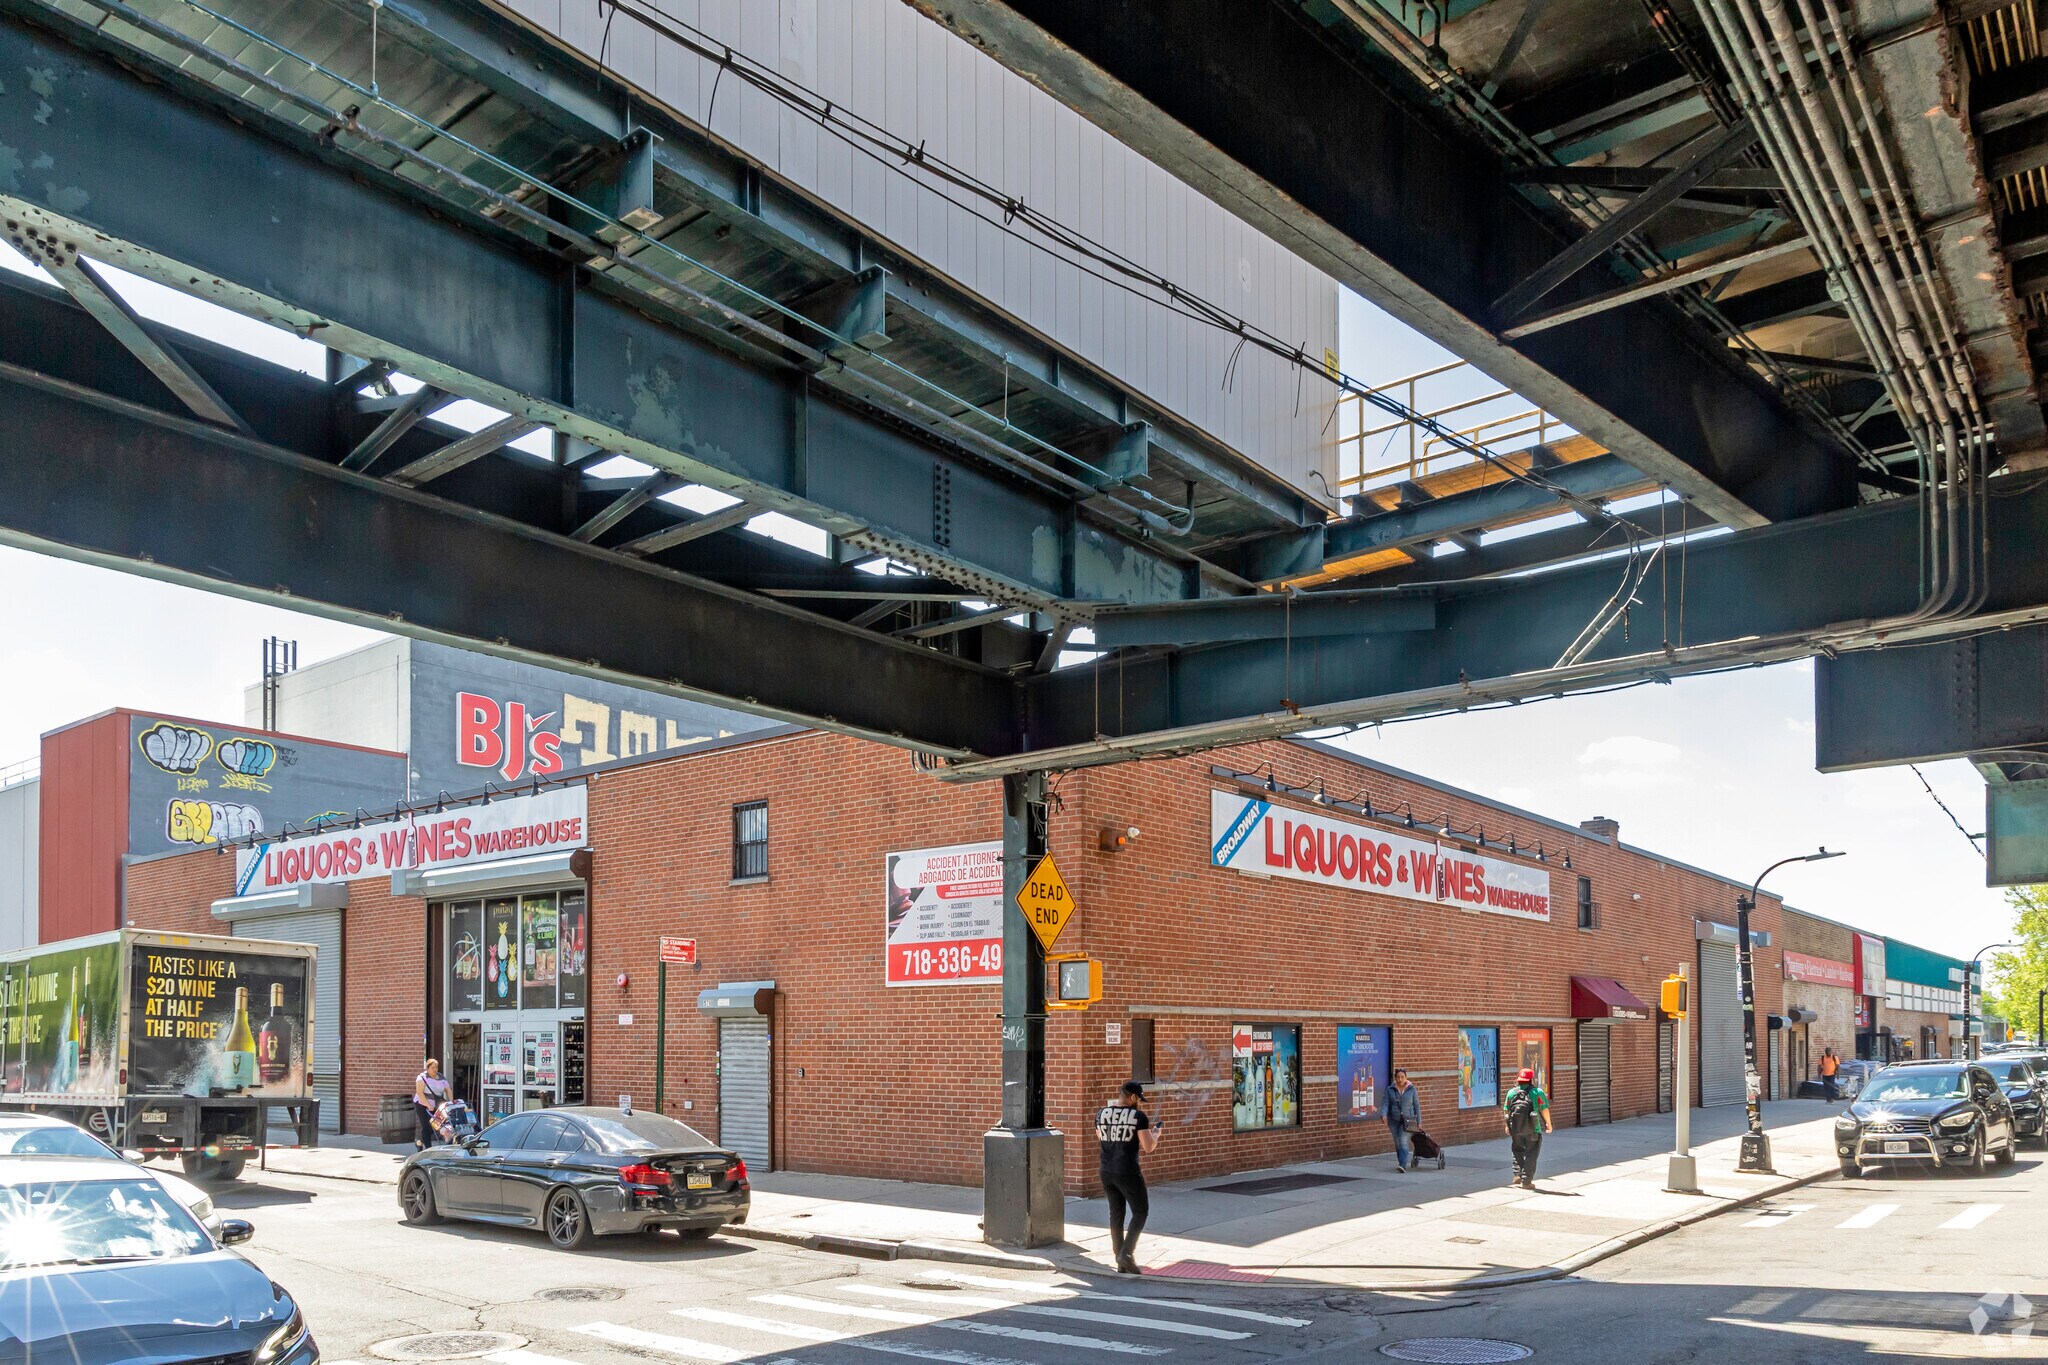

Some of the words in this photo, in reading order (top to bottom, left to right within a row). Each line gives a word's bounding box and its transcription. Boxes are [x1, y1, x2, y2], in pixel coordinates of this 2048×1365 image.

[456, 691, 565, 782] BJ's
[1216, 800, 1263, 867] BROADWAY
[265, 836, 361, 887] LIQUORS
[366, 843, 377, 865] &
[380, 811, 472, 870] WINES
[474, 817, 582, 856] WAREHOUSE
[236, 848, 264, 896] BROADWAY
[927, 855, 962, 870] ACCIDENT
[1265, 816, 1393, 887] LIQUORS
[1397, 855, 1408, 884] &
[1410, 840, 1486, 905] WINES
[1487, 885, 1548, 916] WAREHOUSE
[919, 869, 956, 884] ABOGADOS
[958, 868, 967, 881] DE
[1031, 882, 1063, 901] DEAD
[1036, 908, 1059, 925] END
[148, 955, 195, 976] TASTES
[198, 960, 225, 978] LIKE
[227, 962, 236, 979] A
[38, 972, 59, 1003] WINE
[147, 976, 175, 995] $20
[178, 978, 216, 998] WINE
[145, 998, 164, 1016] AT
[167, 999, 204, 1017] HALF
[9, 1016, 21, 1044] THE
[145, 1019, 173, 1038] THE
[1478, 1034, 1489, 1051] PICK
[1481, 1051, 1496, 1067] YOUR
[1478, 1067, 1496, 1084] PLAYER
[1101, 1107, 1138, 1125] REAL
[1110, 1124, 1136, 1142] GETS
